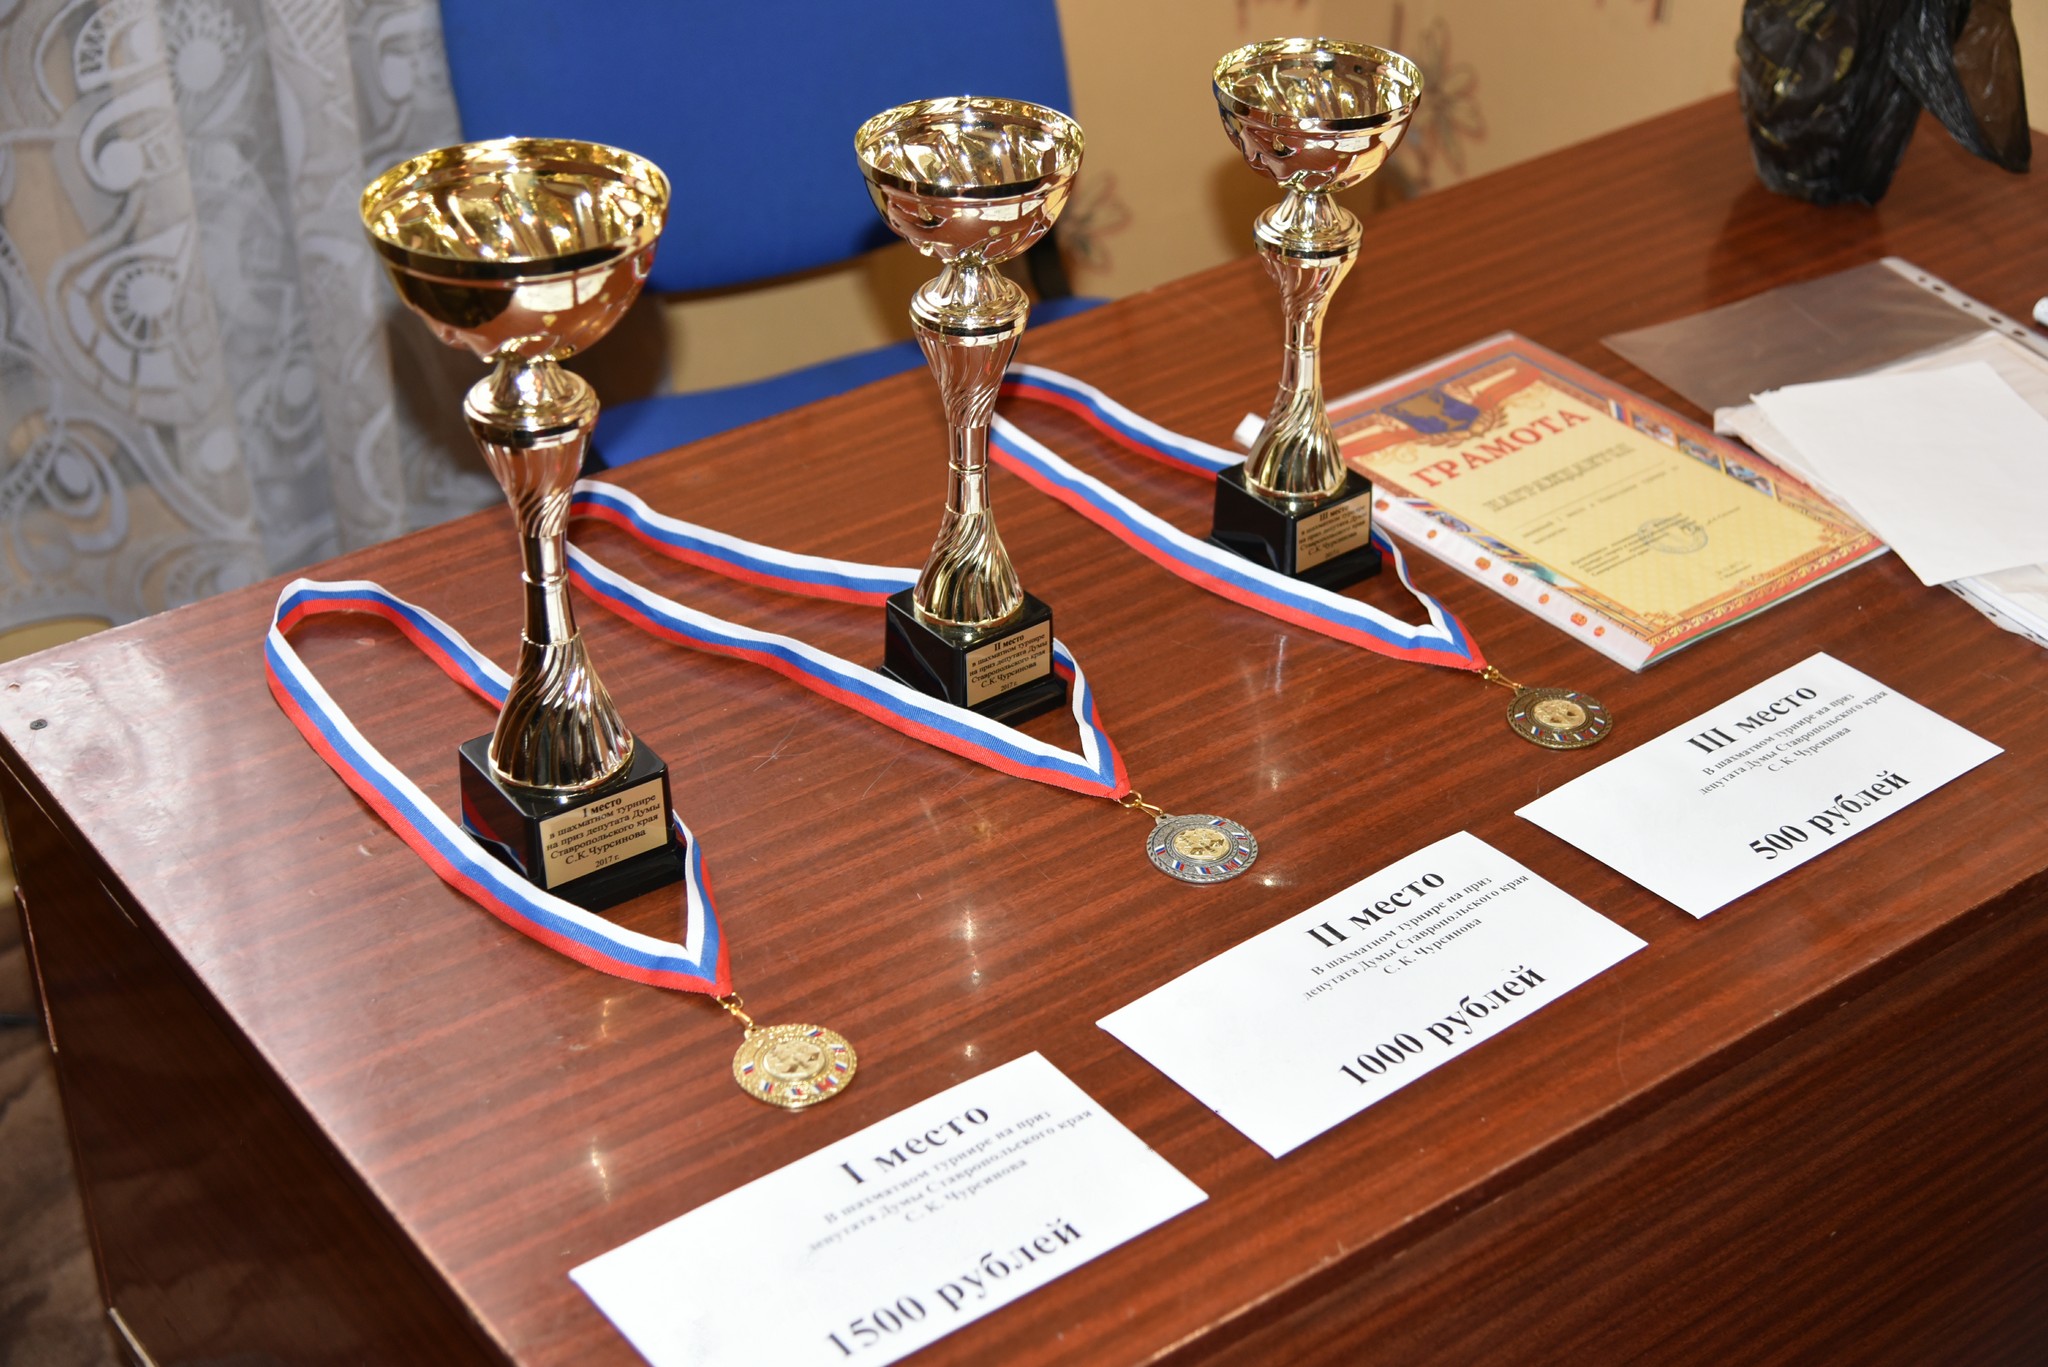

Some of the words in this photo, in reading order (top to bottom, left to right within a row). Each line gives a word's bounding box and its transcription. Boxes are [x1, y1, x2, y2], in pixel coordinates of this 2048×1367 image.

[1409, 407, 1590, 488] ГРАМОТА
[969, 669, 978, 677] на
[979, 662, 996, 674] приз
[996, 649, 1027, 667] депутата
[1028, 641, 1048, 653] Думы
[971, 657, 1029, 684] Ставропольского
[1030, 649, 1046, 661] края
[977, 646, 1016, 665] шахматном
[1018, 634, 1045, 650] турнире
[994, 643, 1001, 652] II
[1003, 634, 1025, 647] место
[1685, 727, 1739, 755] III
[1734, 687, 1818, 734] место
[1699, 765, 1747, 796] депутата
[1745, 749, 1779, 771] Думы
[1775, 704, 1864, 753] Ставропольского
[1864, 690, 1888, 707] края
[1702, 766, 1715, 777] В
[1714, 734, 1775, 771] шахматном
[1774, 713, 1817, 740] турнире
[1814, 706, 1831, 721] на
[1829, 693, 1855, 709] приз
[1768, 762, 1784, 774] С.
[1780, 754, 1797, 767] К.
[1794, 727, 1852, 759] Чурсинова
[546, 842, 558, 851] на
[561, 833, 584, 847] приз
[586, 815, 630, 837] депутата
[632, 803, 660, 820] Думы
[550, 824, 634, 859] Ставропольского
[637, 814, 658, 827] края
[558, 811, 613, 836] шахматном
[617, 795, 656, 814] турнире
[582, 808, 587, 818] I
[591, 797, 622, 814] место
[1748, 824, 1809, 861] 500
[1806, 769, 1912, 836] рублей
[595, 853, 613, 868] 2017
[1302, 967, 1360, 1002] депутата
[1359, 947, 1397, 972] Думы
[1395, 890, 1501, 950] Ставропольского
[1501, 873, 1530, 894] края
[1305, 920, 1351, 949] II
[1347, 872, 1445, 932] место
[1310, 965, 1325, 977] В
[1325, 929, 1398, 970] шахматном
[1397, 902, 1448, 932] турнире
[1447, 892, 1464, 906] на
[1464, 876, 1493, 896] приз
[1383, 963, 1402, 975] С.
[1398, 954, 1417, 967] К.
[1414, 917, 1482, 957] Чурсинова
[1338, 1033, 1424, 1086] 1000
[1424, 964, 1548, 1047] рублей
[823, 1212, 839, 1225] В
[841, 1169, 930, 1217] шахматном
[929, 1138, 995, 1172] турнире
[995, 1127, 1015, 1143] на
[1015, 1109, 1052, 1131] приз
[839, 1160, 865, 1186] I
[873, 1107, 990, 1173] место
[880, 1190, 925, 1219] Думы
[925, 1125, 1057, 1194] Ставропольского
[1058, 1109, 1094, 1131] края
[943, 1158, 1029, 1201] Чурсинова
[826, 1294, 928, 1357] 1500
[935, 1217, 1083, 1313] рублей
